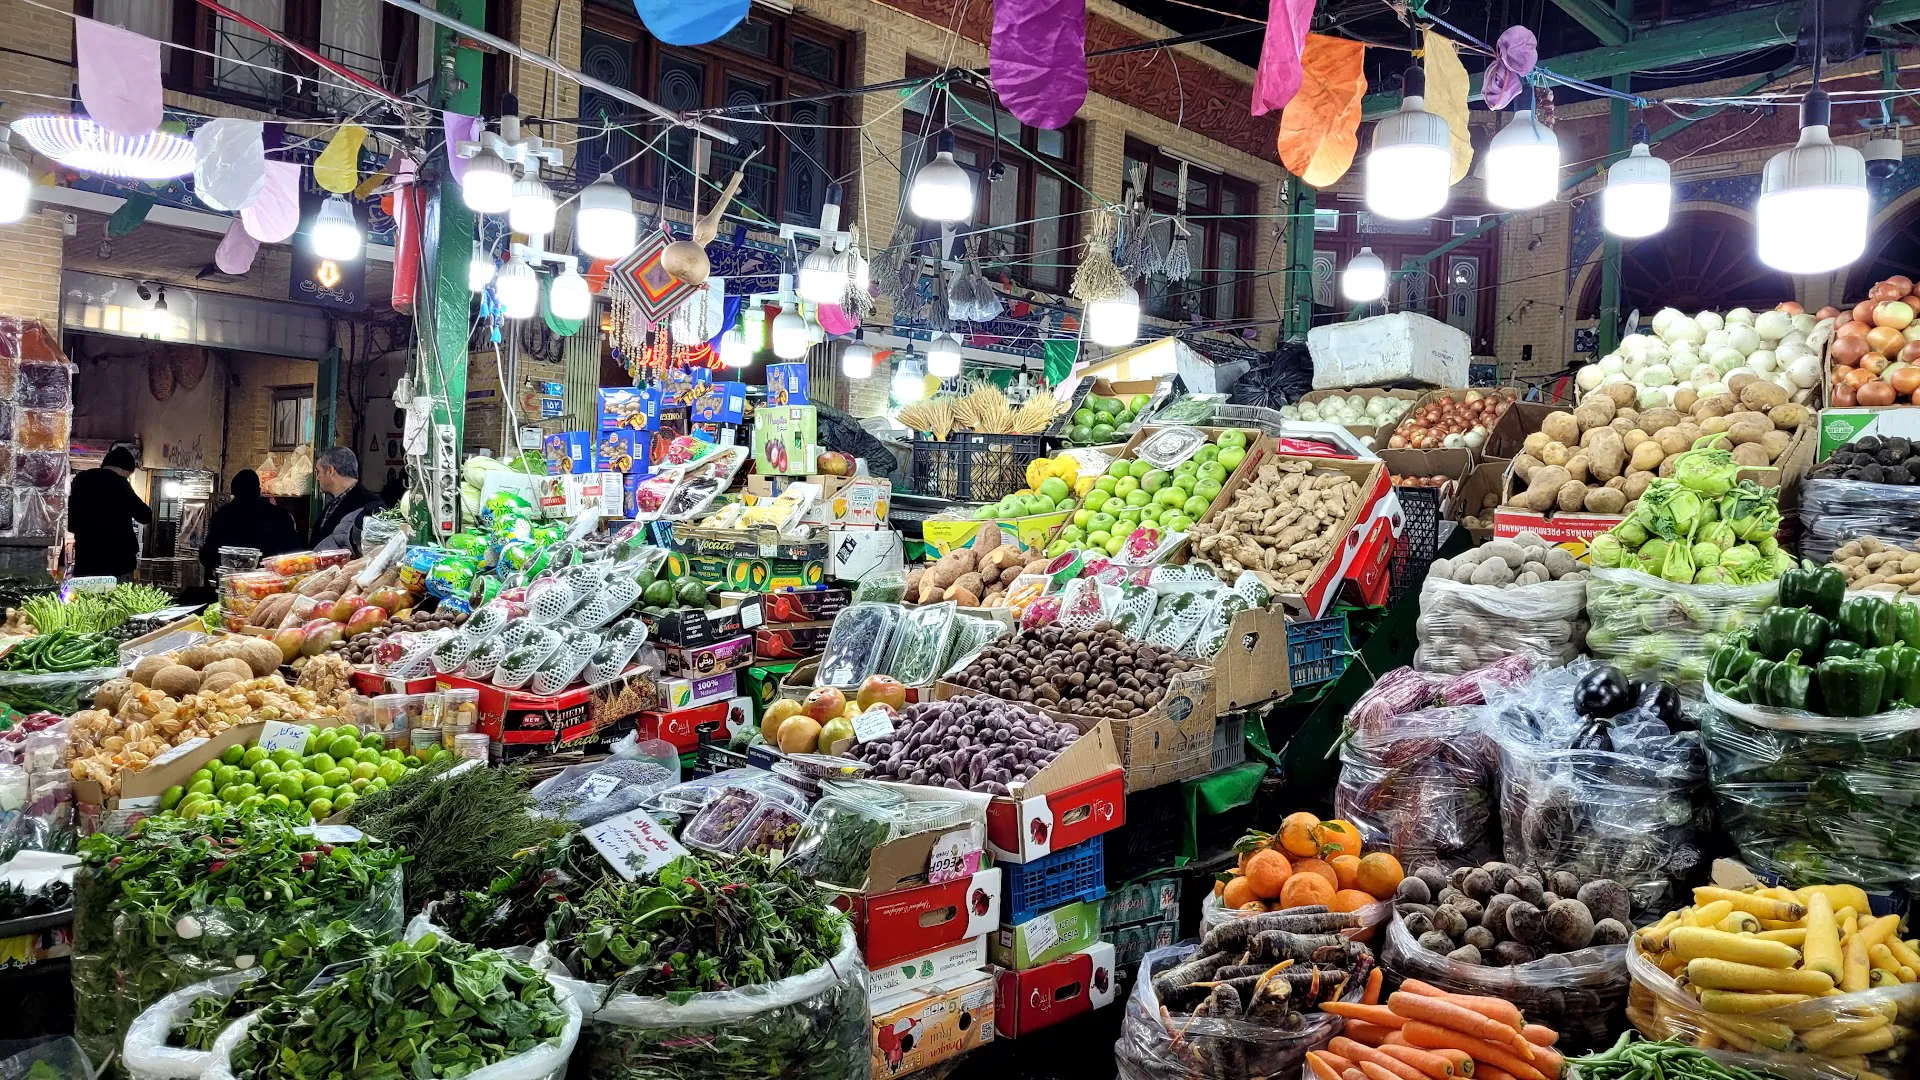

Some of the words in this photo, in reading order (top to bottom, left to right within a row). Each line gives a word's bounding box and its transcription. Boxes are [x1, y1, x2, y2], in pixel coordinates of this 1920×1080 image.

[697, 679, 719, 691] 100%
[700, 687, 718, 697] Natural
[929, 1038, 962, 1058] Dragon
